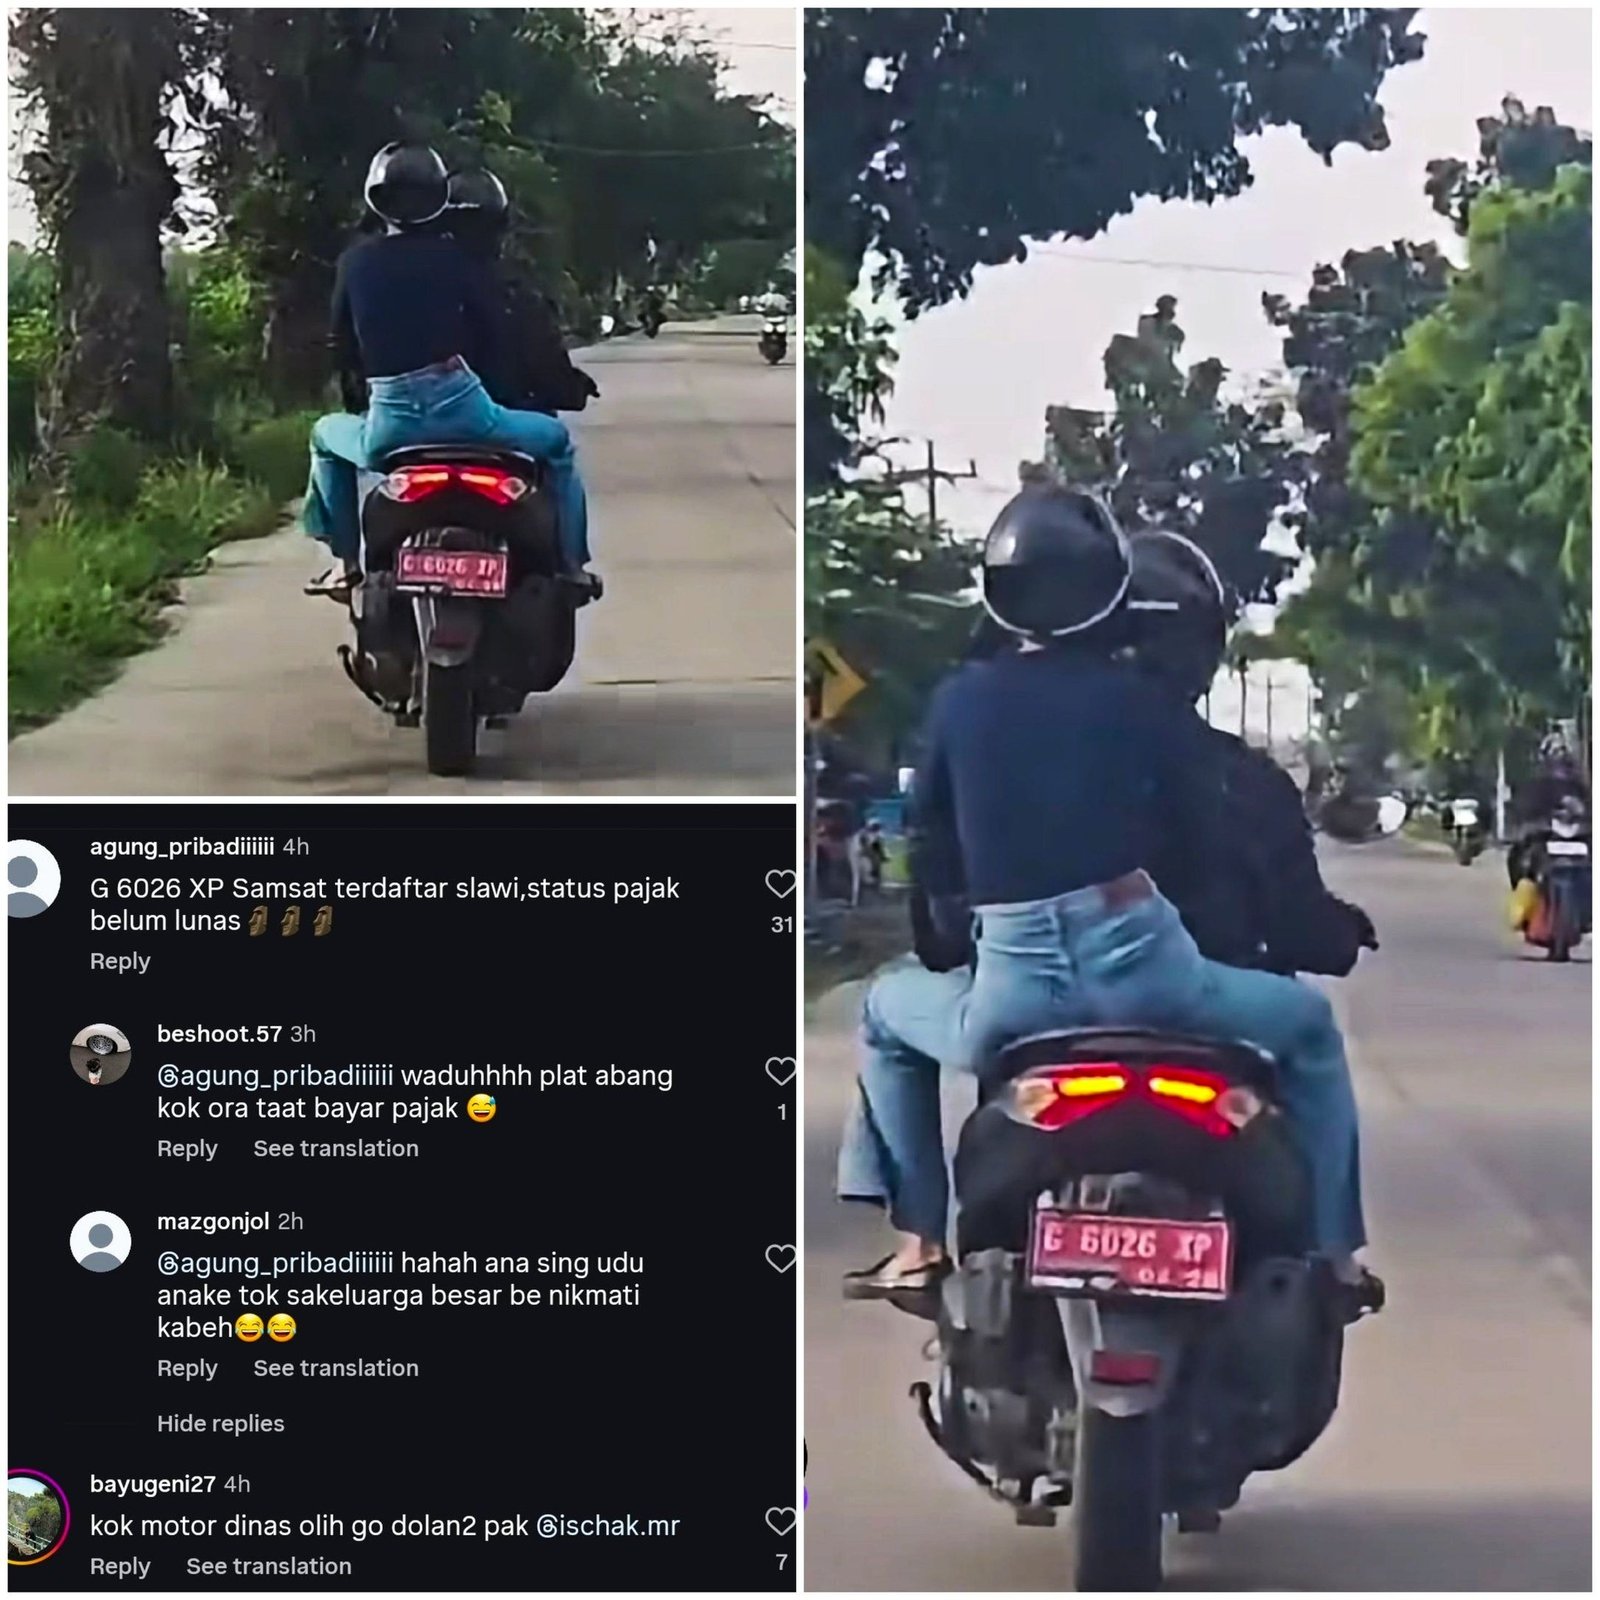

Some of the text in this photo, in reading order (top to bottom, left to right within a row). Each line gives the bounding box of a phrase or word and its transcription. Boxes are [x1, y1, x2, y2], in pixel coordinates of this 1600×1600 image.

[90, 836, 309, 861] agung_pribadiiiiii 4h
[90, 876, 680, 905] G 6026 XP Samsat terdaftar slawi,status pajak
[90, 908, 241, 931] belum lunas
[771, 916, 793, 934] 31
[90, 950, 152, 975] Reply
[157, 1023, 316, 1043] beshoot.57 3h
[157, 1063, 673, 1092] @agung_pribadiiiiii waduhhhh plat abang
[158, 1095, 459, 1124] kok ora taat bayar pajak
[777, 1103, 786, 1121] 1
[157, 1138, 219, 1162] Reply
[253, 1138, 419, 1157] See translation
[157, 1211, 304, 1235] mazgonjol 2h
[1043, 1221, 1213, 1262] G 6026 XP
[157, 1250, 644, 1279] @agung_pribadiiiiii hahah ana sing udu
[157, 1283, 640, 1312] anake tok sakeluarga besar be nikmati
[158, 1315, 233, 1338] kabeh
[158, 1357, 219, 1382] Reply
[253, 1357, 419, 1377] See translation
[157, 1413, 285, 1438] Hide replies
[90, 1473, 251, 1498] bayugeni27 4h
[90, 1513, 681, 1542] kok motor dinas olih go dolan2 pak @ischak.mr
[90, 1555, 152, 1580] Reply
[186, 1555, 352, 1575] See translation
[775, 1553, 789, 1571] 7
